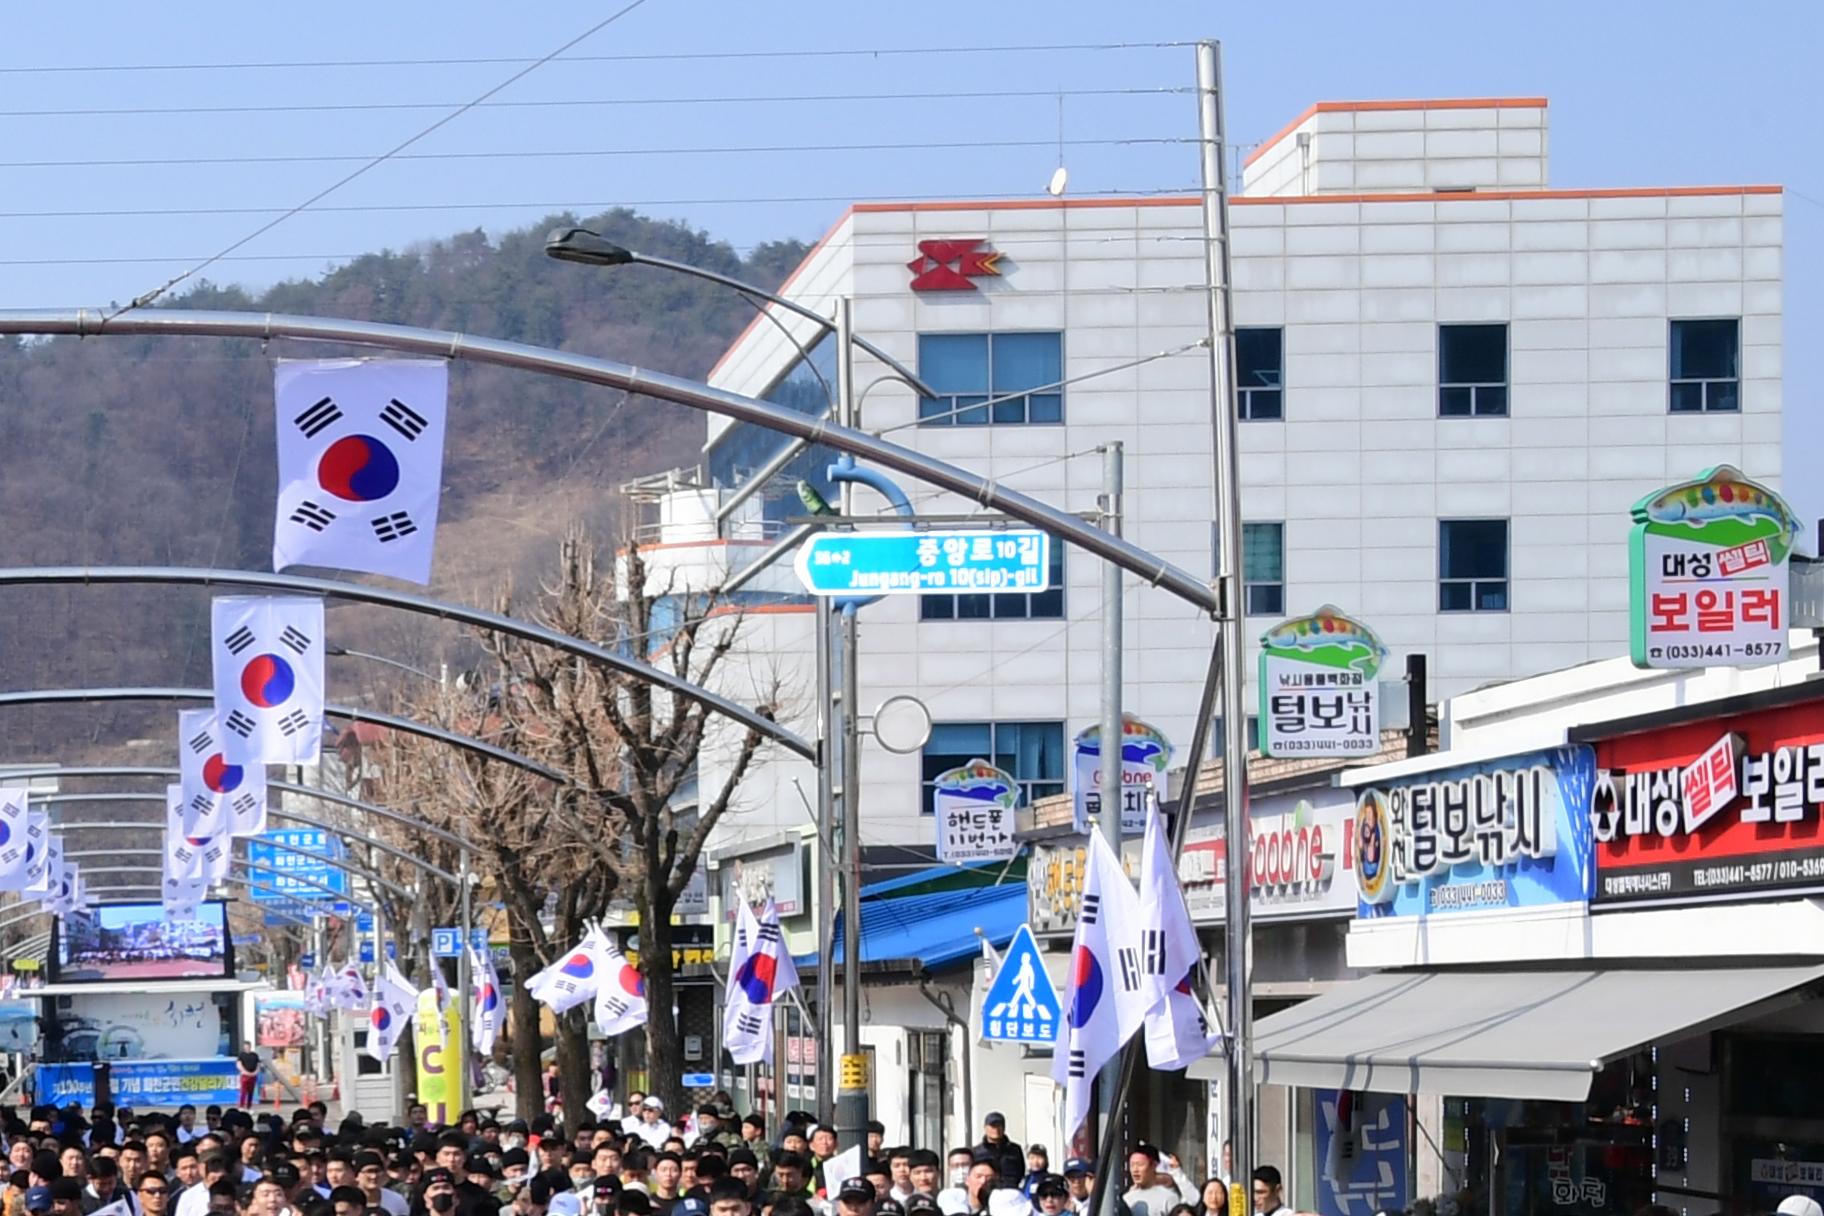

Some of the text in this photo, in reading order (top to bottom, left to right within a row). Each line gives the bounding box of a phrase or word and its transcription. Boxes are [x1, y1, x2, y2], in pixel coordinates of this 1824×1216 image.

[1662, 552, 1711, 577] 대성
[1651, 588, 1780, 633] 보일러
[948, 809, 1004, 832] 핸드폰
[1625, 766, 1678, 837] 대성
[1246, 813, 1322, 888] oobne
